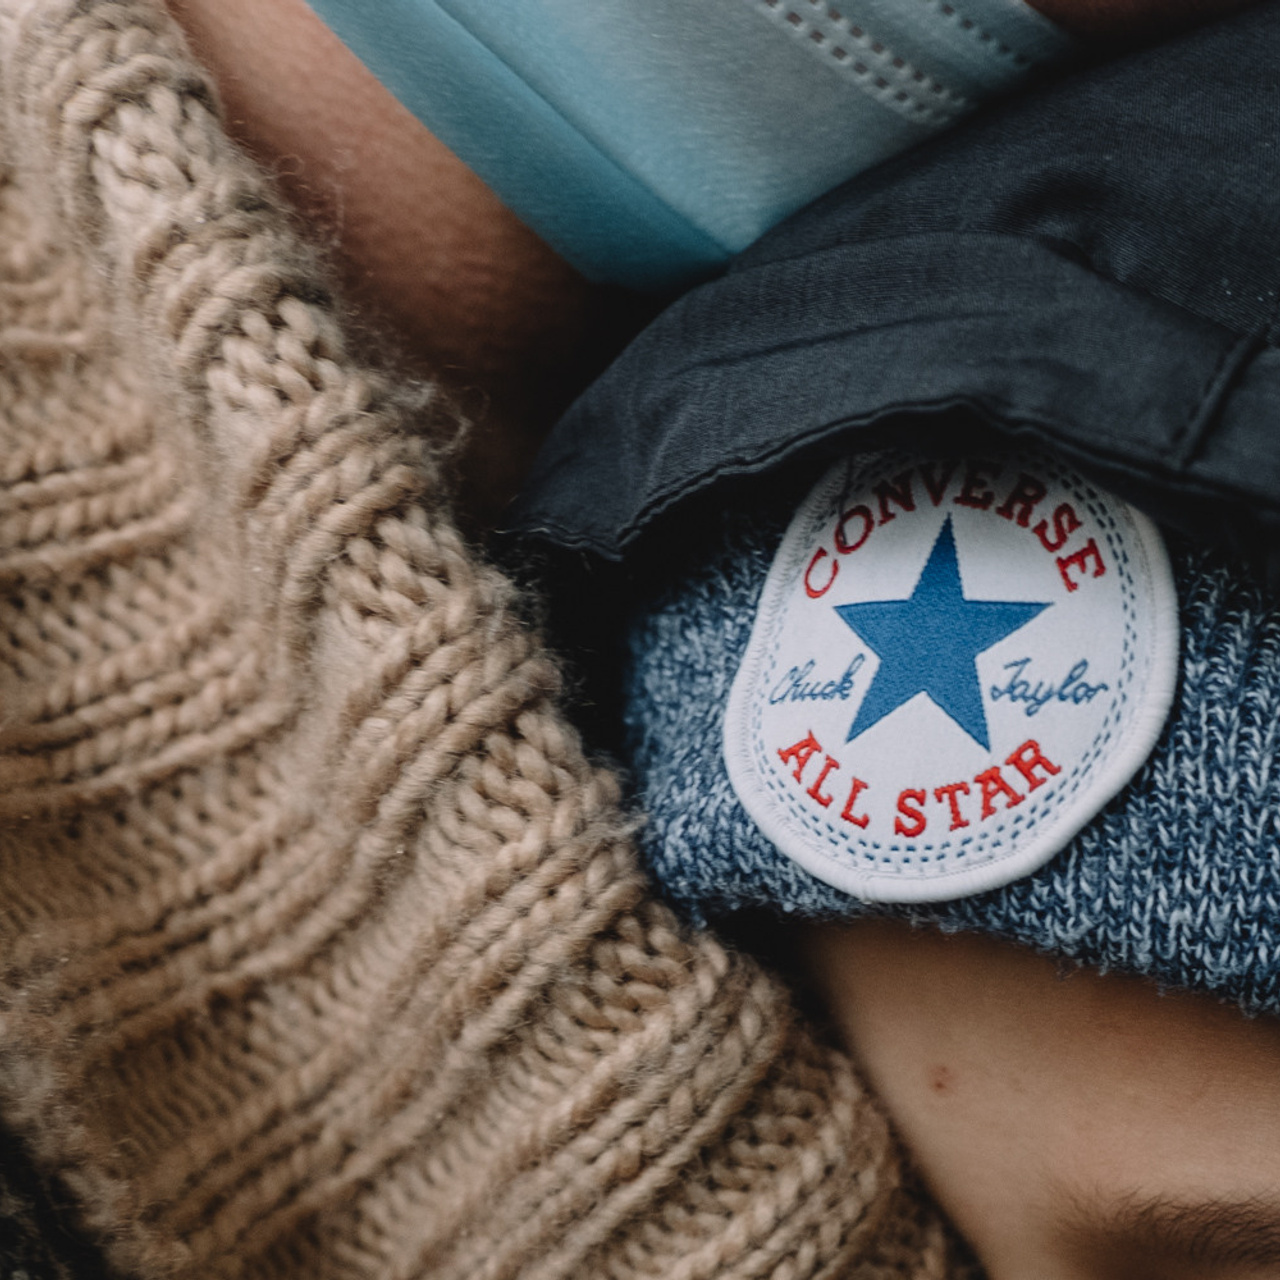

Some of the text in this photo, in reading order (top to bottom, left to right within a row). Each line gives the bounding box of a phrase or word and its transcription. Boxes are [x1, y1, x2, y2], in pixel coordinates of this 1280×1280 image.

[804, 461, 1106, 598] CONVERSE
[769, 653, 1108, 716] Chuck Taylor
[777, 729, 1062, 838] ALL STAR
